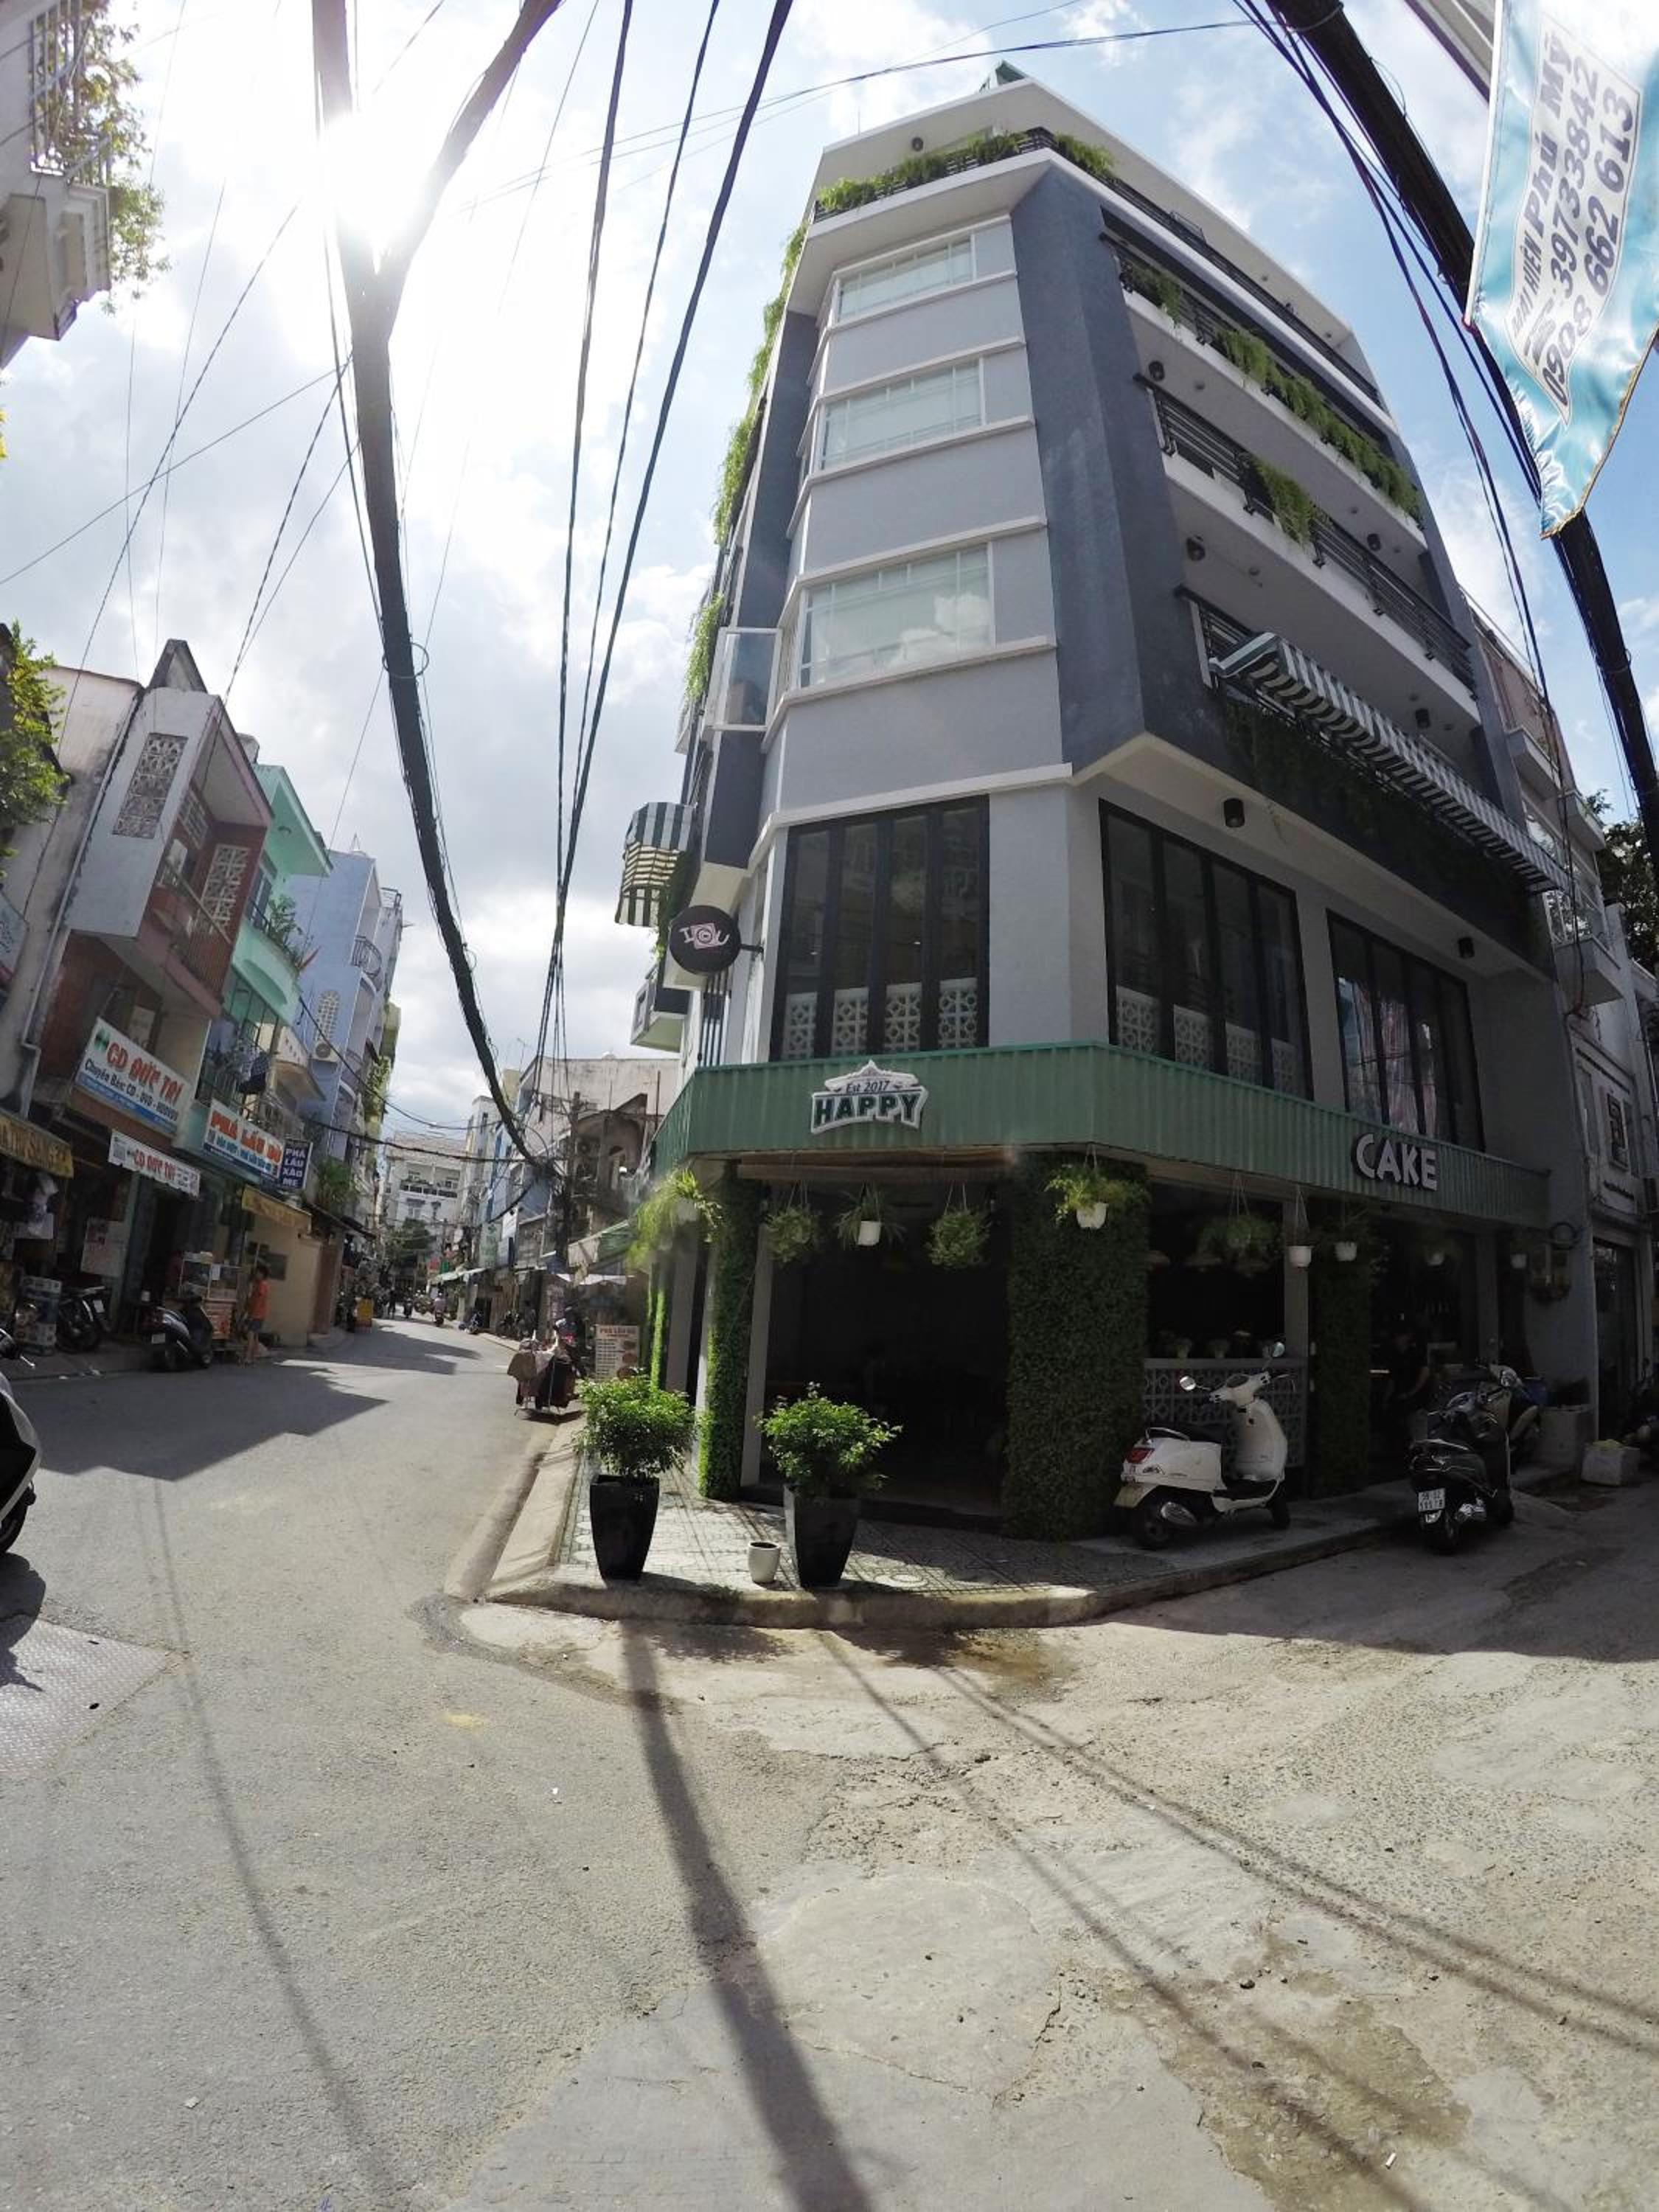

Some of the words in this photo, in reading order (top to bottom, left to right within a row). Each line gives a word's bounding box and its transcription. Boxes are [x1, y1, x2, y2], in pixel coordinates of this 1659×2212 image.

[1594, 86, 1633, 193] 613
[1524, 131, 1558, 239] Phú
[1520, 230, 1542, 295] HIÊN
[1585, 195, 1619, 296] 662
[1543, 295, 1592, 406] 0908
[107, 1042, 128, 1070] CD
[846, 1083, 860, 1093] Est
[864, 1080, 891, 1092] 2017
[813, 1093, 922, 1129] HAPPY
[1356, 1133, 1437, 1192] CAKE
